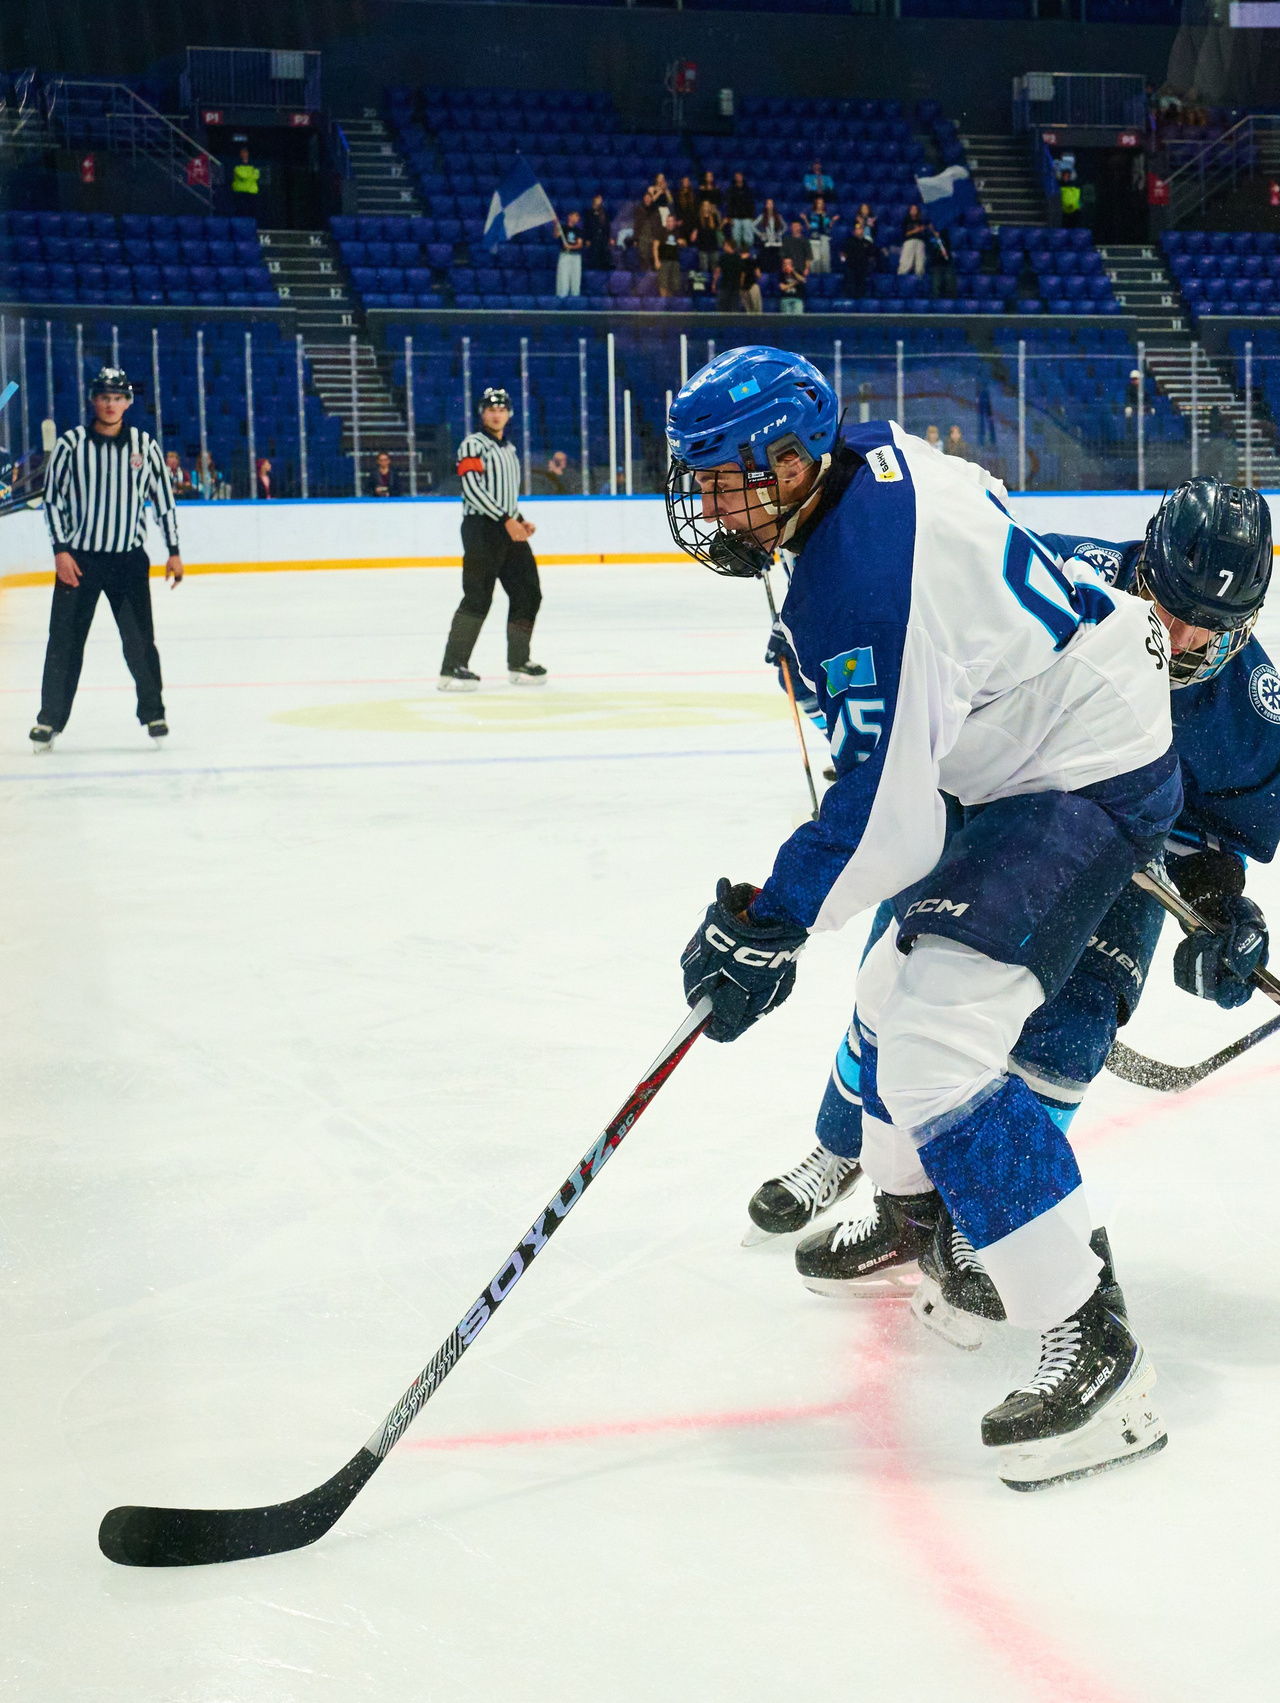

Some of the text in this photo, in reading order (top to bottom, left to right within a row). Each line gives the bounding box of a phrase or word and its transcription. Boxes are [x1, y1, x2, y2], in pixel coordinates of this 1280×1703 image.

[206, 112, 219, 123] P1
[294, 115, 309, 126] P2
[259, 235, 321, 246] 14 14
[268, 262, 280, 273] 13
[279, 287, 342, 299] 12 12
[1161, 295, 1172, 307] 12
[341, 314, 352, 326] 11
[1172, 320, 1182, 331] 11
[1216, 569, 1234, 597] 7
[905, 898, 970, 918] CCM
[705, 923, 801, 970] CCM
[1237, 932, 1257, 953] CCM
[458, 1130, 614, 1345] SOYUZ
[857, 1250, 899, 1271] BAUER
[1081, 1366, 1112, 1406] BAUER
[386, 1405, 410, 1438] ACE
[409, 1372, 436, 1410] prime
